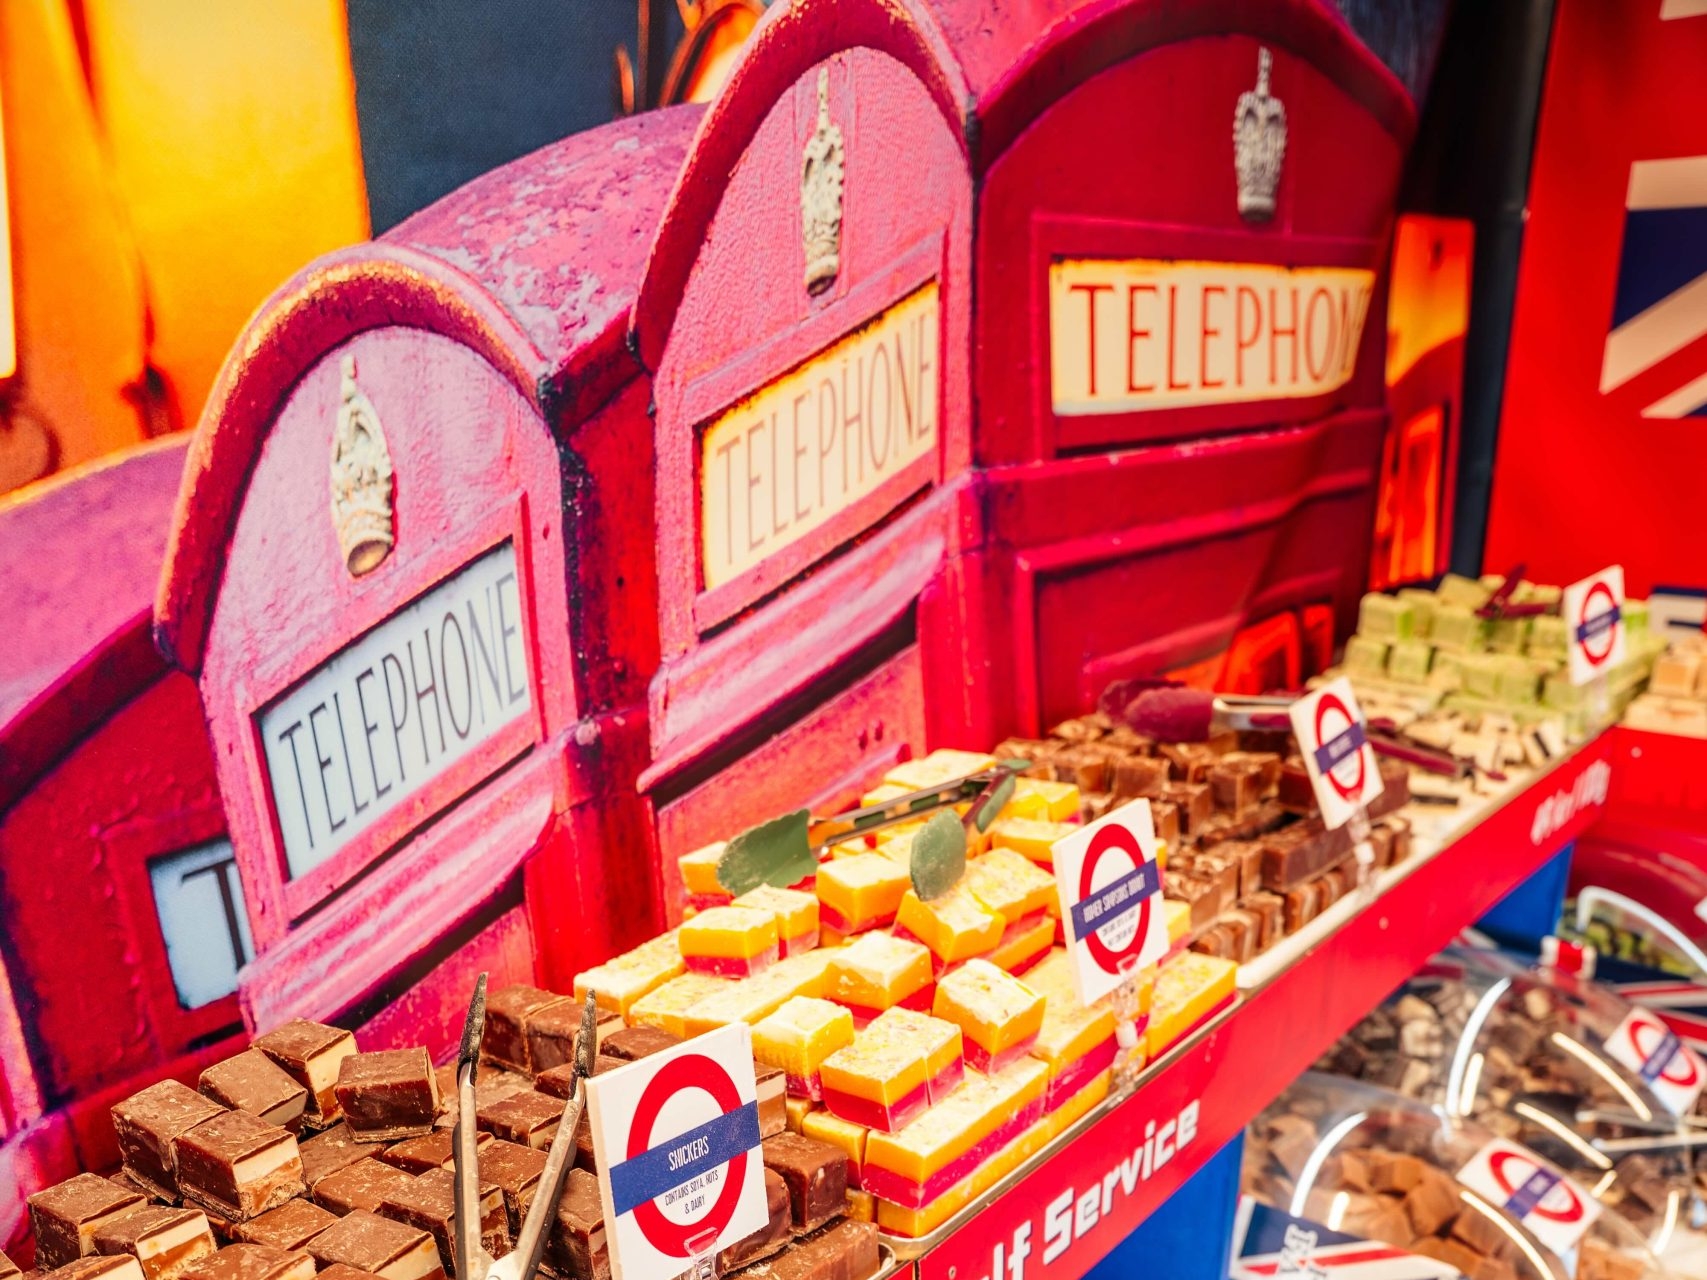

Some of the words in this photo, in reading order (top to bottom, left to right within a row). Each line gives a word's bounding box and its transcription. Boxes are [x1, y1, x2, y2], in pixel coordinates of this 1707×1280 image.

[716, 313, 931, 565] TELEPHONE
[279, 572, 525, 848] TELEPHONE
[665, 1184, 689, 1206] CONTAINS
[705, 1170, 719, 1185] NUTS
[668, 1135, 709, 1171] SNICKERS
[1043, 1099, 1201, 1266] Service
[685, 1203, 690, 1215] &
[691, 1194, 705, 1211] DAIRY
